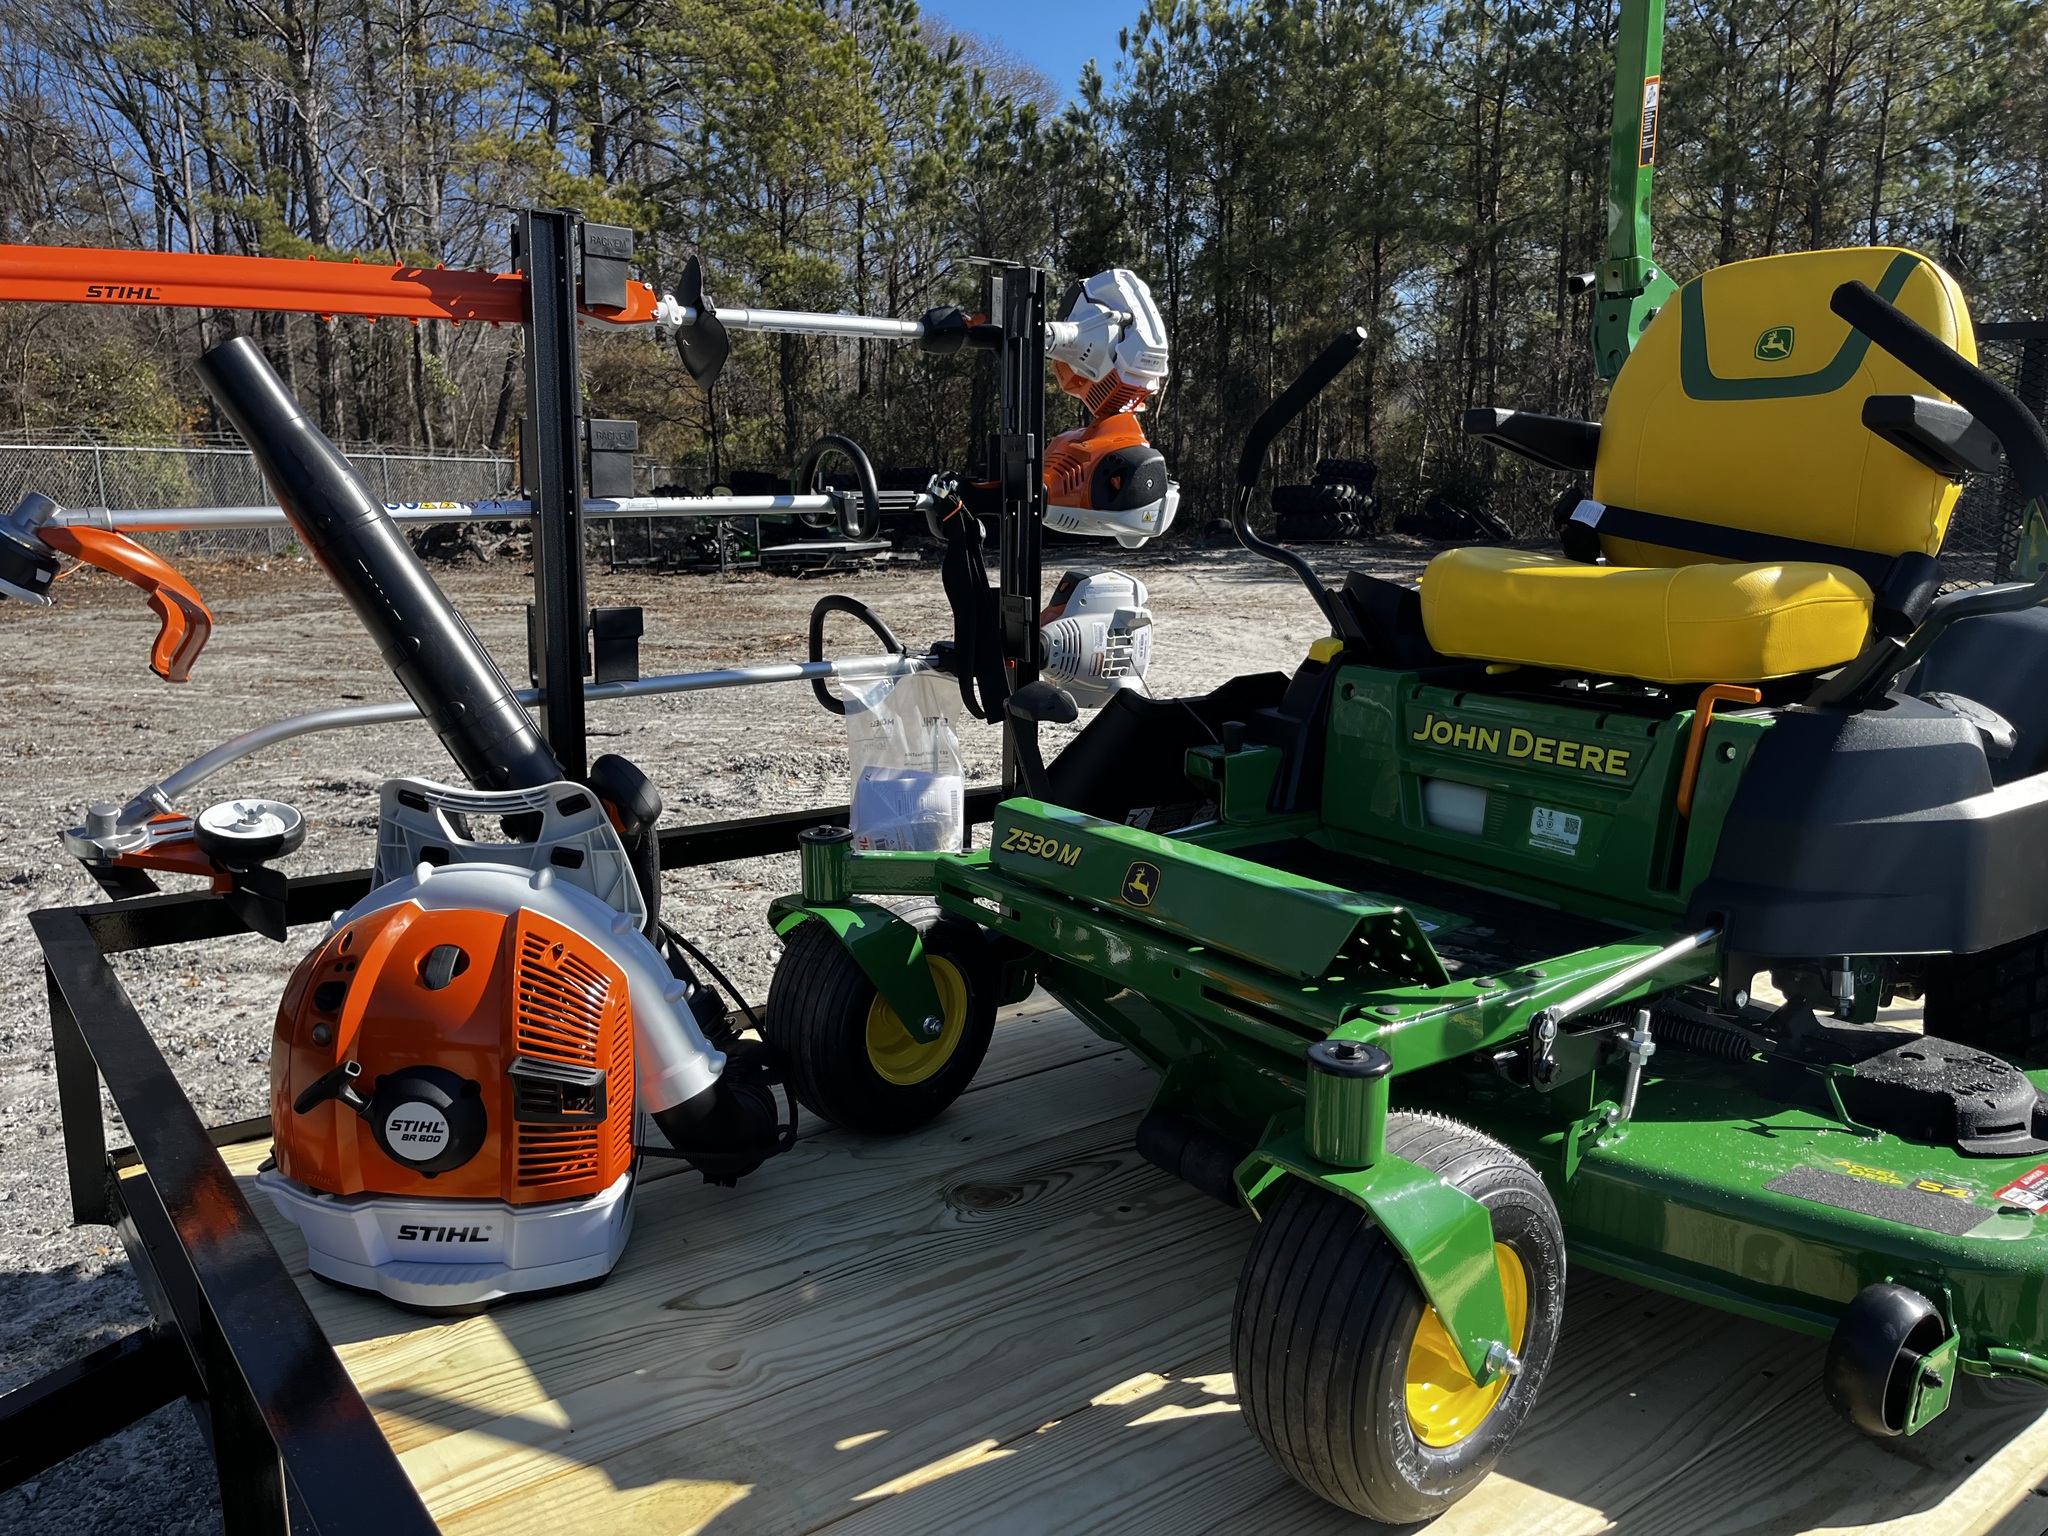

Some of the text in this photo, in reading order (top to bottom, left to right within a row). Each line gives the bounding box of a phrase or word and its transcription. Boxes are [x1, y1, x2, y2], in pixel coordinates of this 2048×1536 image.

[85, 285, 160, 300] STIHL
[1412, 713, 1630, 777] JOHN DEERE
[1000, 827, 1083, 867] Z530 M
[389, 1119, 444, 1134] STIHL
[401, 1133, 442, 1143] BR 600
[1915, 1179, 1968, 1199] 54
[397, 1224, 490, 1243] STIHL
